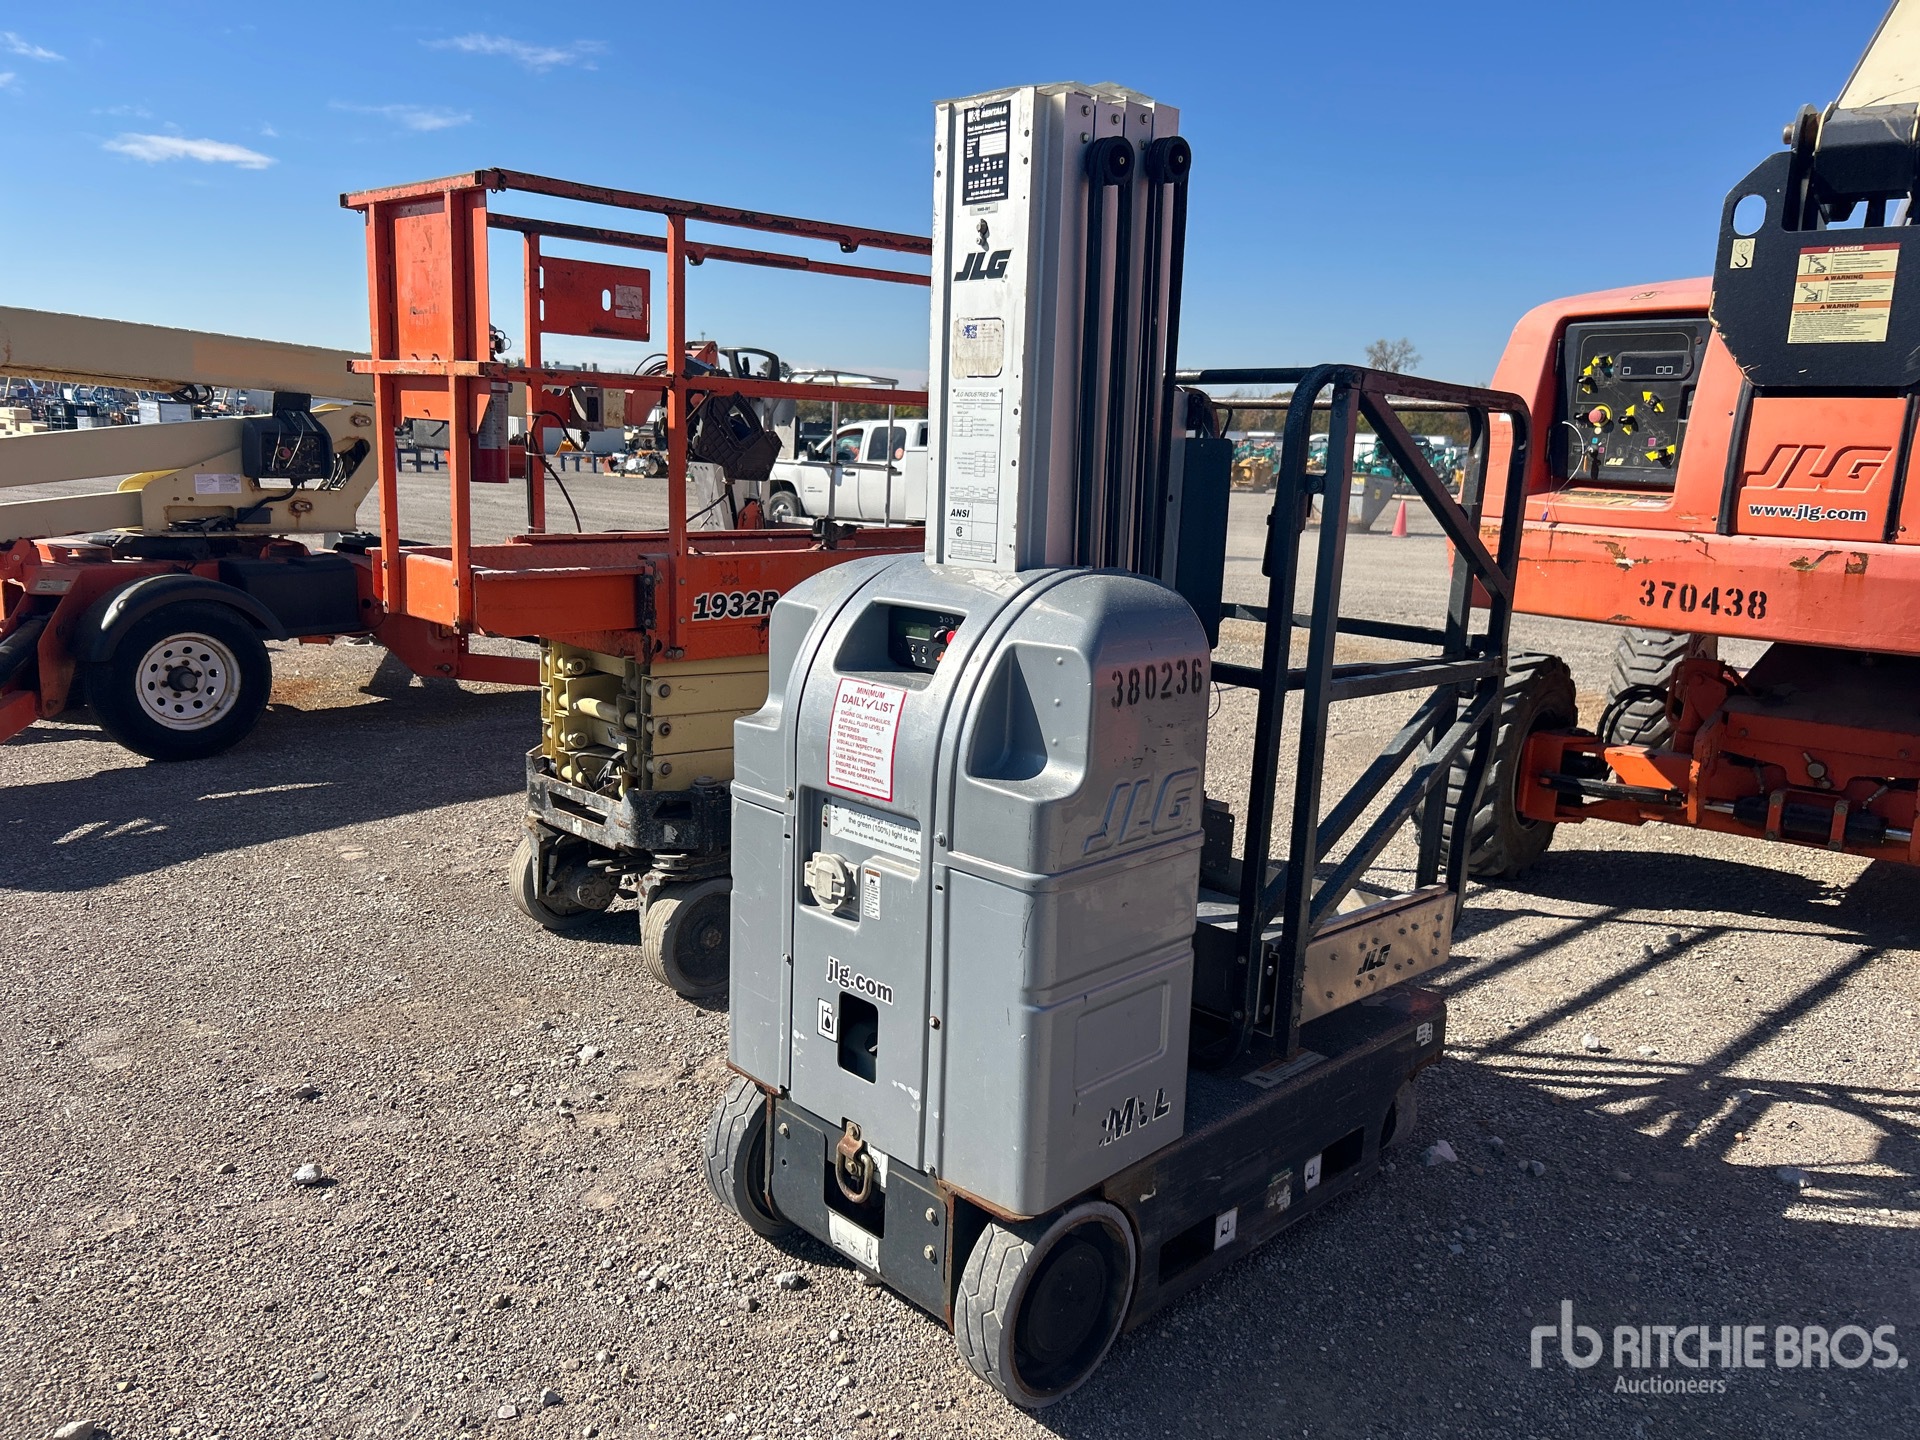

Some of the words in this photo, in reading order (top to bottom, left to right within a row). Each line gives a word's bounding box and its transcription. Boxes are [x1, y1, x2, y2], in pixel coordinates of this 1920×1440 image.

[954, 250, 1011, 281] JLG
[1743, 443, 1893, 493] JLG
[950, 508, 970, 518] ANSI
[1750, 504, 1867, 522] www.jlg.com
[1639, 580, 1768, 619] 370438
[1111, 658, 1203, 708] 380236
[857, 687, 885, 699] MINIMUM
[842, 694, 867, 707] DAILY
[875, 701, 895, 713] LIST
[838, 724, 859, 733] BATTERIES
[869, 723, 884, 731] LEVELS
[847, 733, 868, 743] PRESSURE
[856, 743, 873, 751] INSPECT
[857, 772, 884, 784] OPERATIONAL
[860, 766, 875, 774] SAFETY
[1083, 767, 1198, 855] JLG
[857, 820, 871, 829] green
[892, 830, 902, 840] light
[1357, 944, 1391, 975] JLG
[827, 958, 893, 1003] jlg.com
